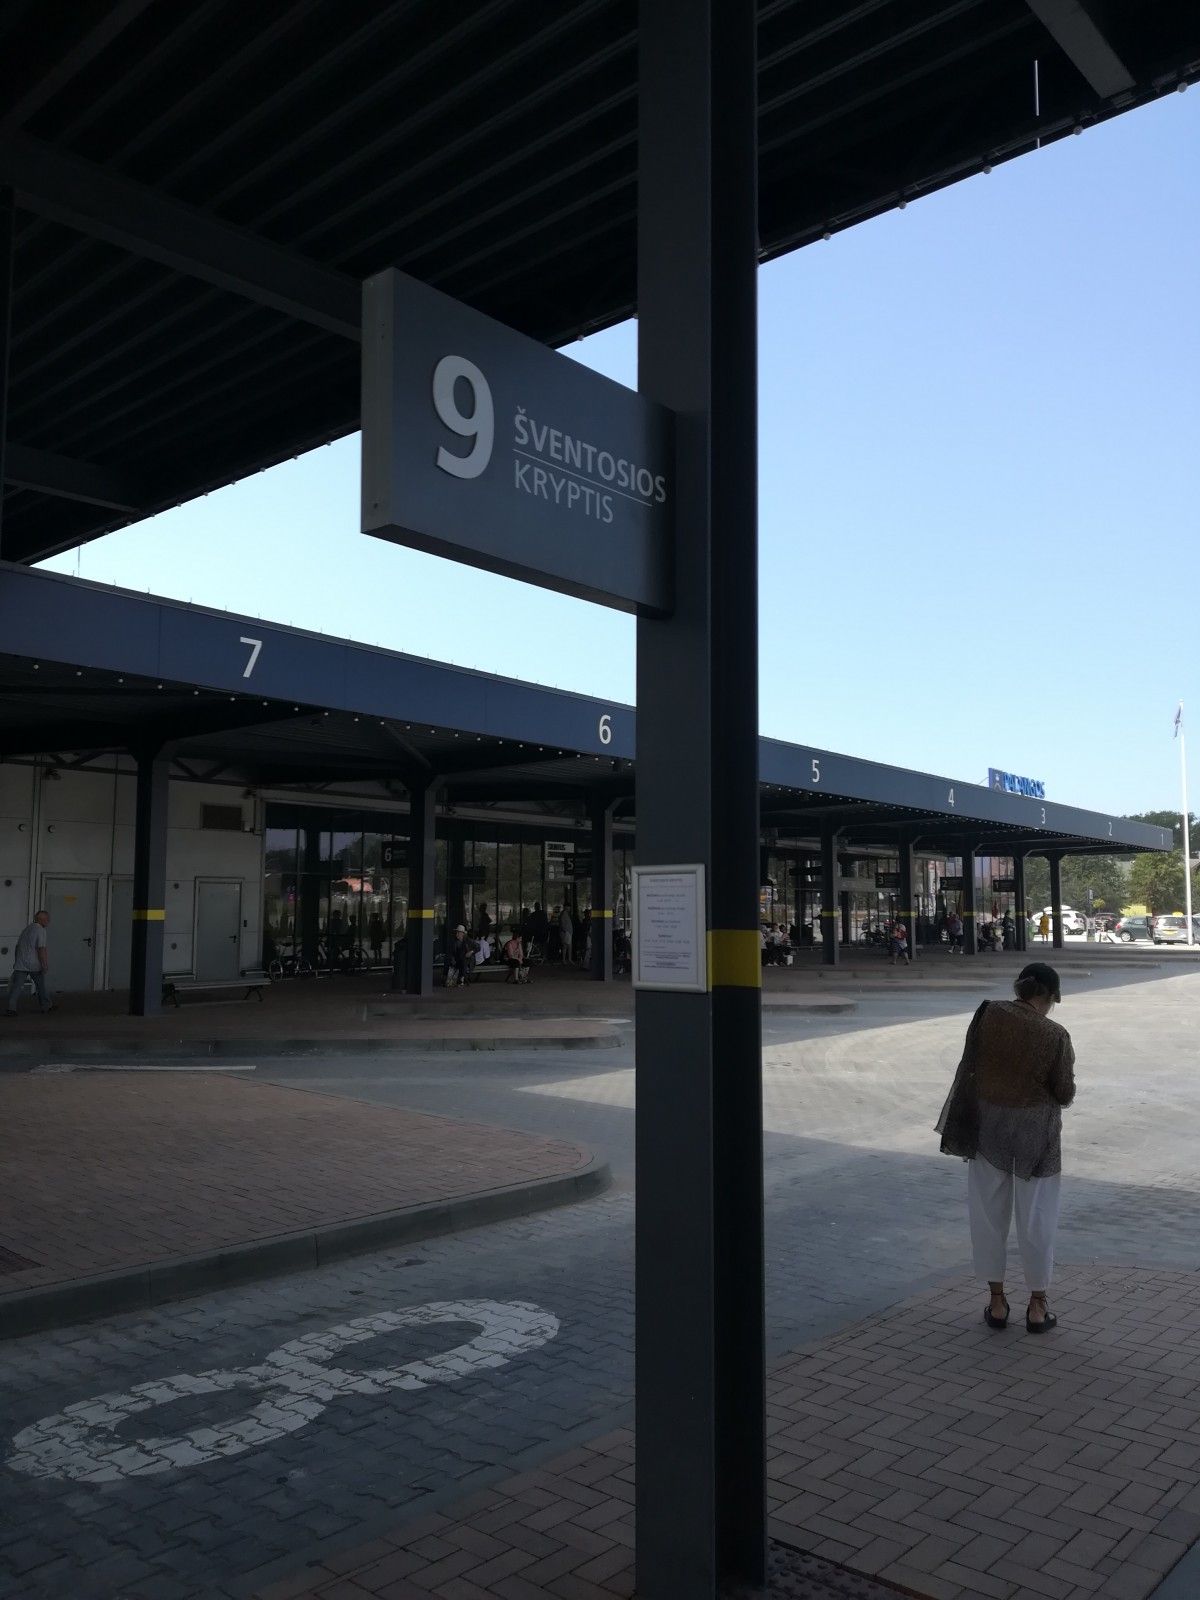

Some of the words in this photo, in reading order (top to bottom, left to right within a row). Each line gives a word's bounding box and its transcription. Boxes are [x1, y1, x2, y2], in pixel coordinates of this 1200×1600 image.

[432, 354, 495, 480] 9
[513, 405, 667, 504] ŠVENTOSIOS
[513, 459, 614, 524] KRYPTIS
[240, 636, 263, 678] 7
[598, 714, 612, 745] 6
[812, 759, 820, 783] 5
[948, 788, 955, 807] 4
[1041, 808, 1046, 824] 3
[3, 1298, 562, 1483] 8
